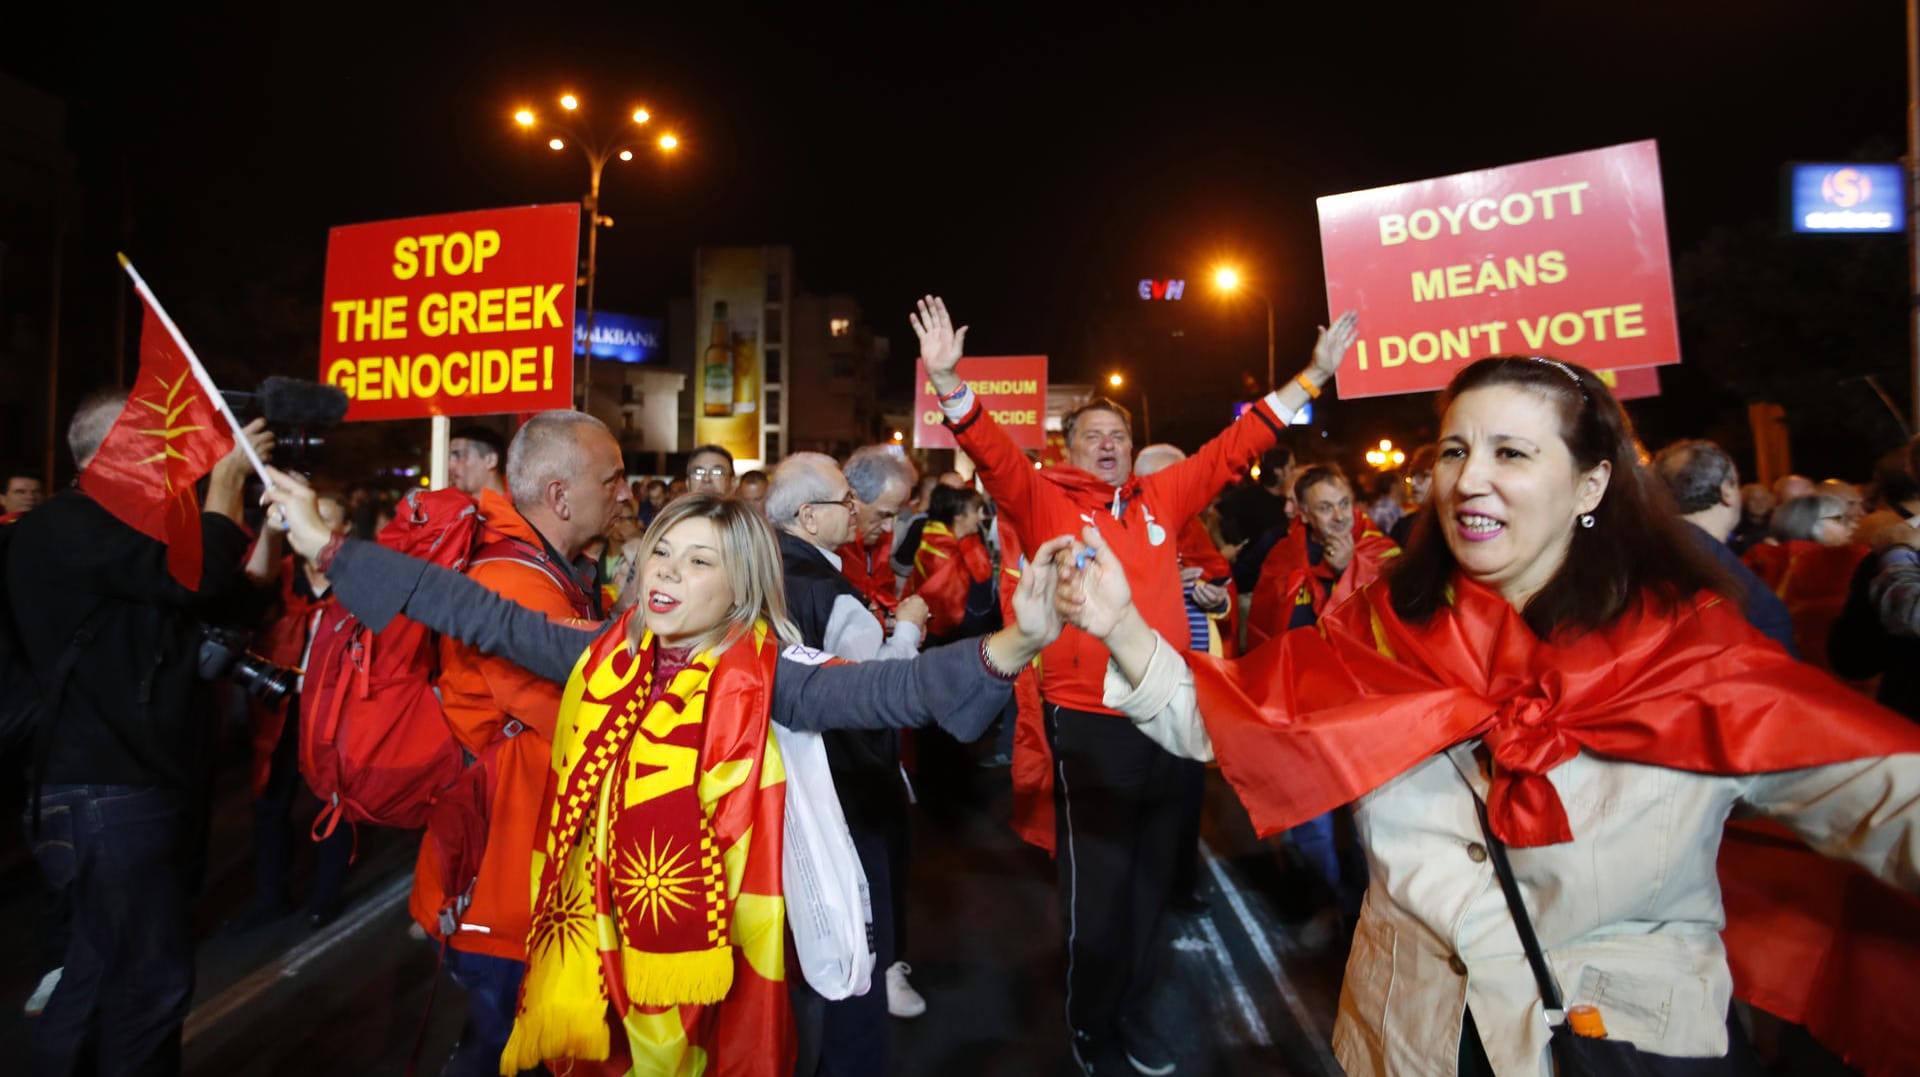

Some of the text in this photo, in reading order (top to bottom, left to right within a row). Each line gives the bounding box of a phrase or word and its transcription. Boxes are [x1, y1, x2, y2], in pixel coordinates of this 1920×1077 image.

[1378, 181, 1590, 246] BOYCOTT
[392, 229, 501, 280] STOP
[1411, 250, 1568, 303] MEANS
[331, 283, 565, 343] THE GREEK
[1357, 303, 1647, 370] I DON'T VOTE
[327, 345, 554, 401] GENOCIDE!
[925, 380, 1038, 395] RRENDUM
